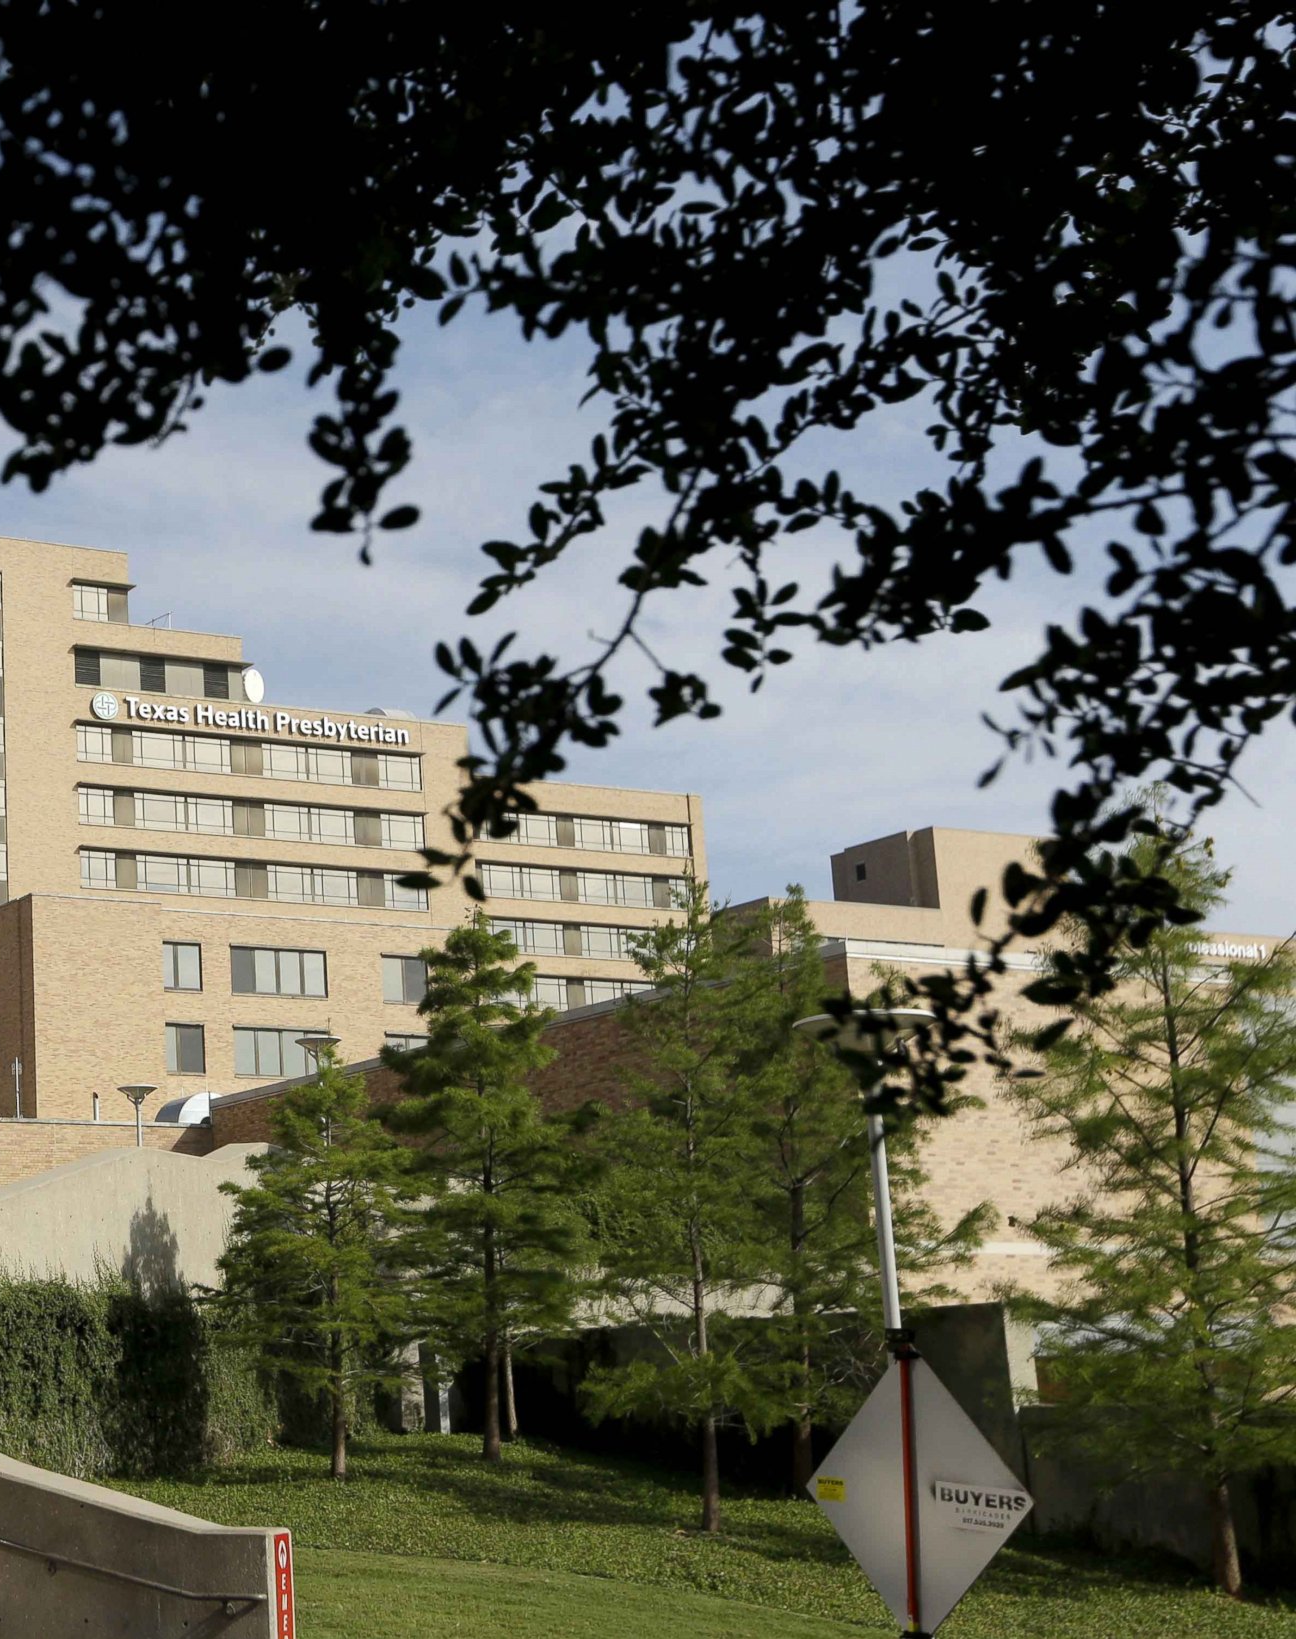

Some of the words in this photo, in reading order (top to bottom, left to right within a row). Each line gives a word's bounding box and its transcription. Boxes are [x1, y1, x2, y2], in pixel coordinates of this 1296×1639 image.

[125, 696, 189, 722] Texas
[195, 703, 269, 731] Health
[276, 711, 410, 744] Presbyterian
[940, 1486, 1026, 1511] BUYERS
